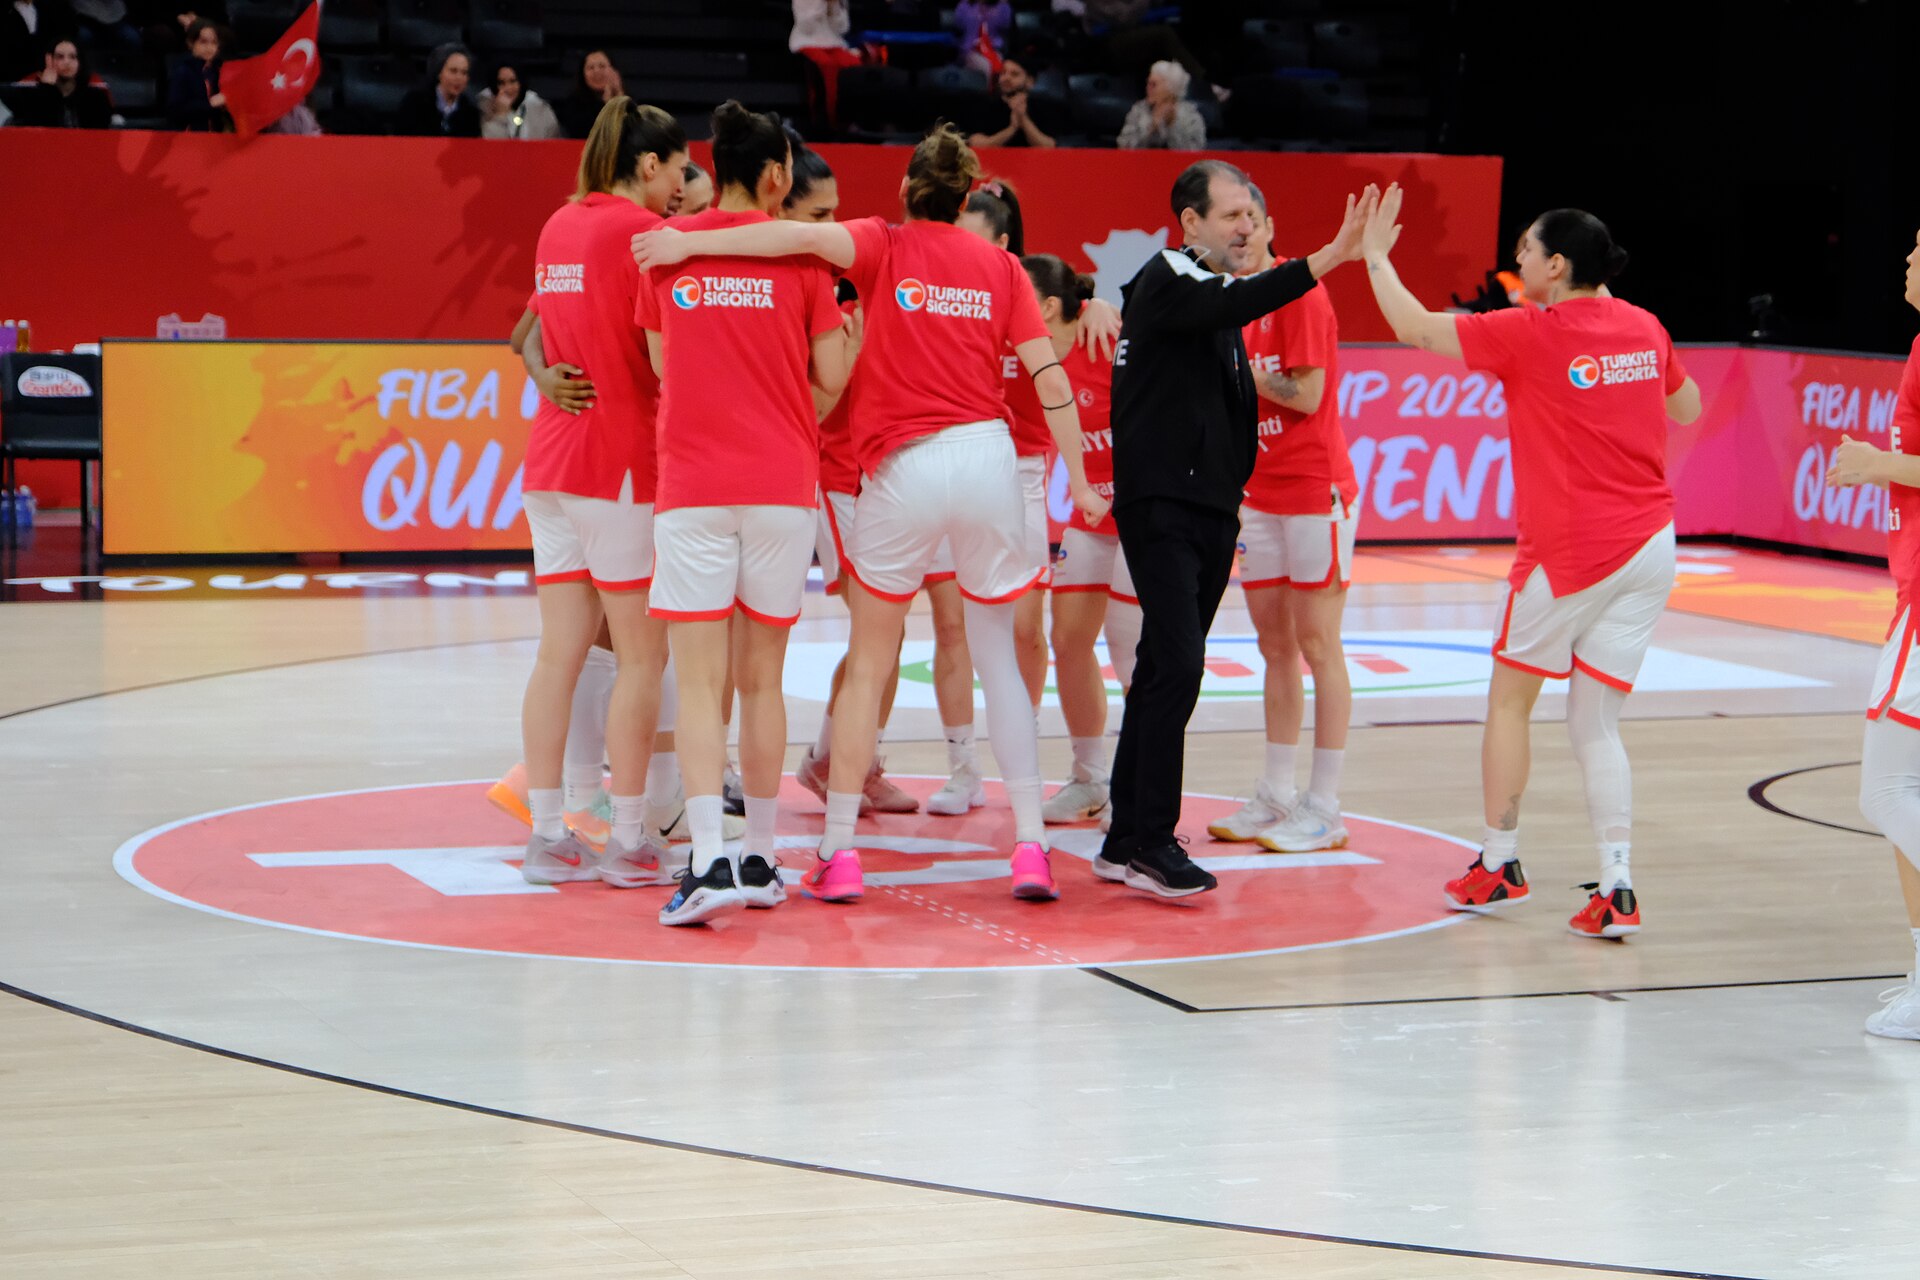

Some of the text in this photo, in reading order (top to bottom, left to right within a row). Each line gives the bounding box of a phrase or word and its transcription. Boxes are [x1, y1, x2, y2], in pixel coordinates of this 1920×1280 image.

[376, 368, 499, 420] FIBA
[1398, 372, 1507, 419] 2026
[1802, 381, 1861, 431] FIBA
